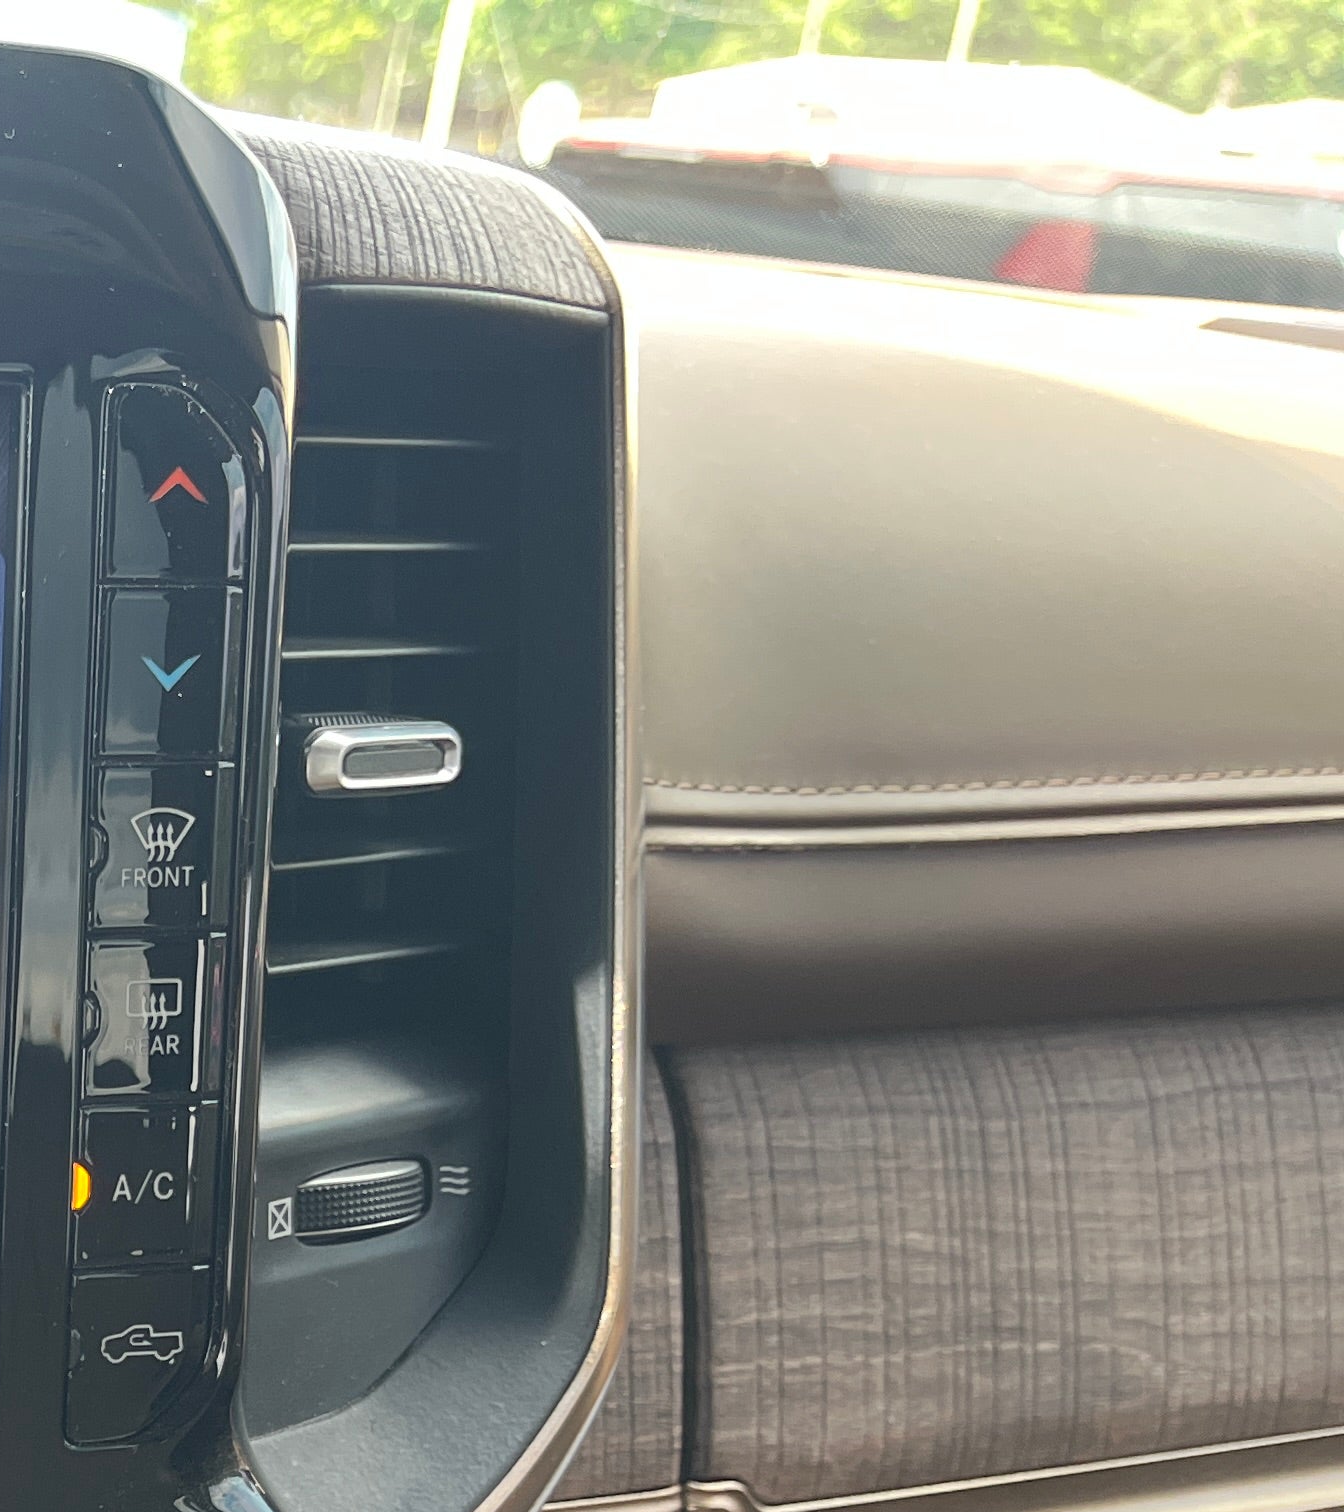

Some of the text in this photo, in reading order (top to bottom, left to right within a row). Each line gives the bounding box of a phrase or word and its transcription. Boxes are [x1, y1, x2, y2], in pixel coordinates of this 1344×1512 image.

[120, 865, 195, 889] FRONT
[123, 1033, 180, 1057] REAR
[112, 1170, 175, 1204] A/C
